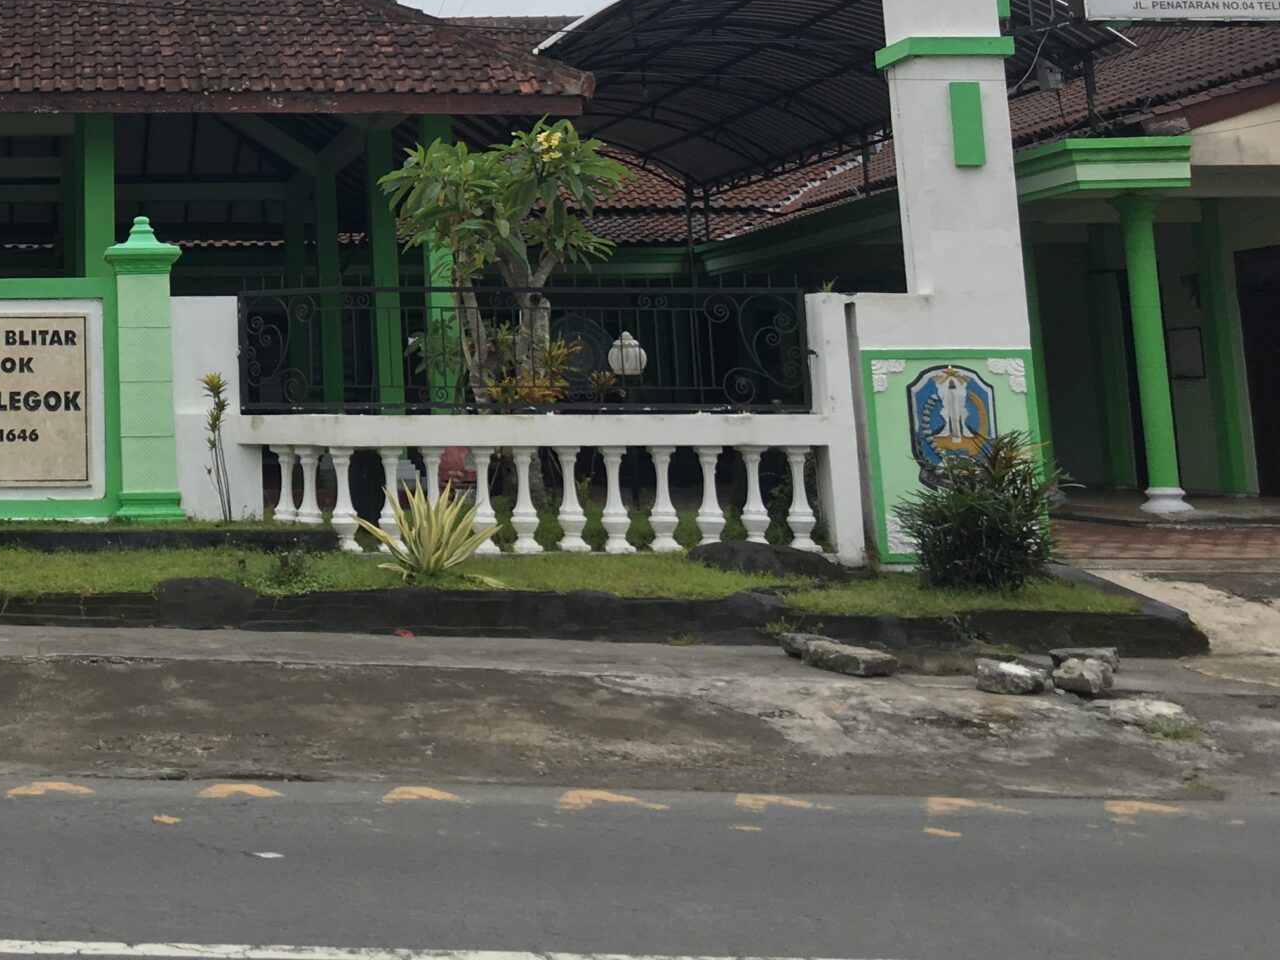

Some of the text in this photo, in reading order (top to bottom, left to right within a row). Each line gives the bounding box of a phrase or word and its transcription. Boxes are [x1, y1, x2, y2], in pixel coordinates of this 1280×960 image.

[1132, 1, 1149, 10] JL.
[1151, 0, 1220, 10] PENATARAN
[1222, 1, 1255, 10] NO.04
[4, 329, 77, 346] BLITAR
